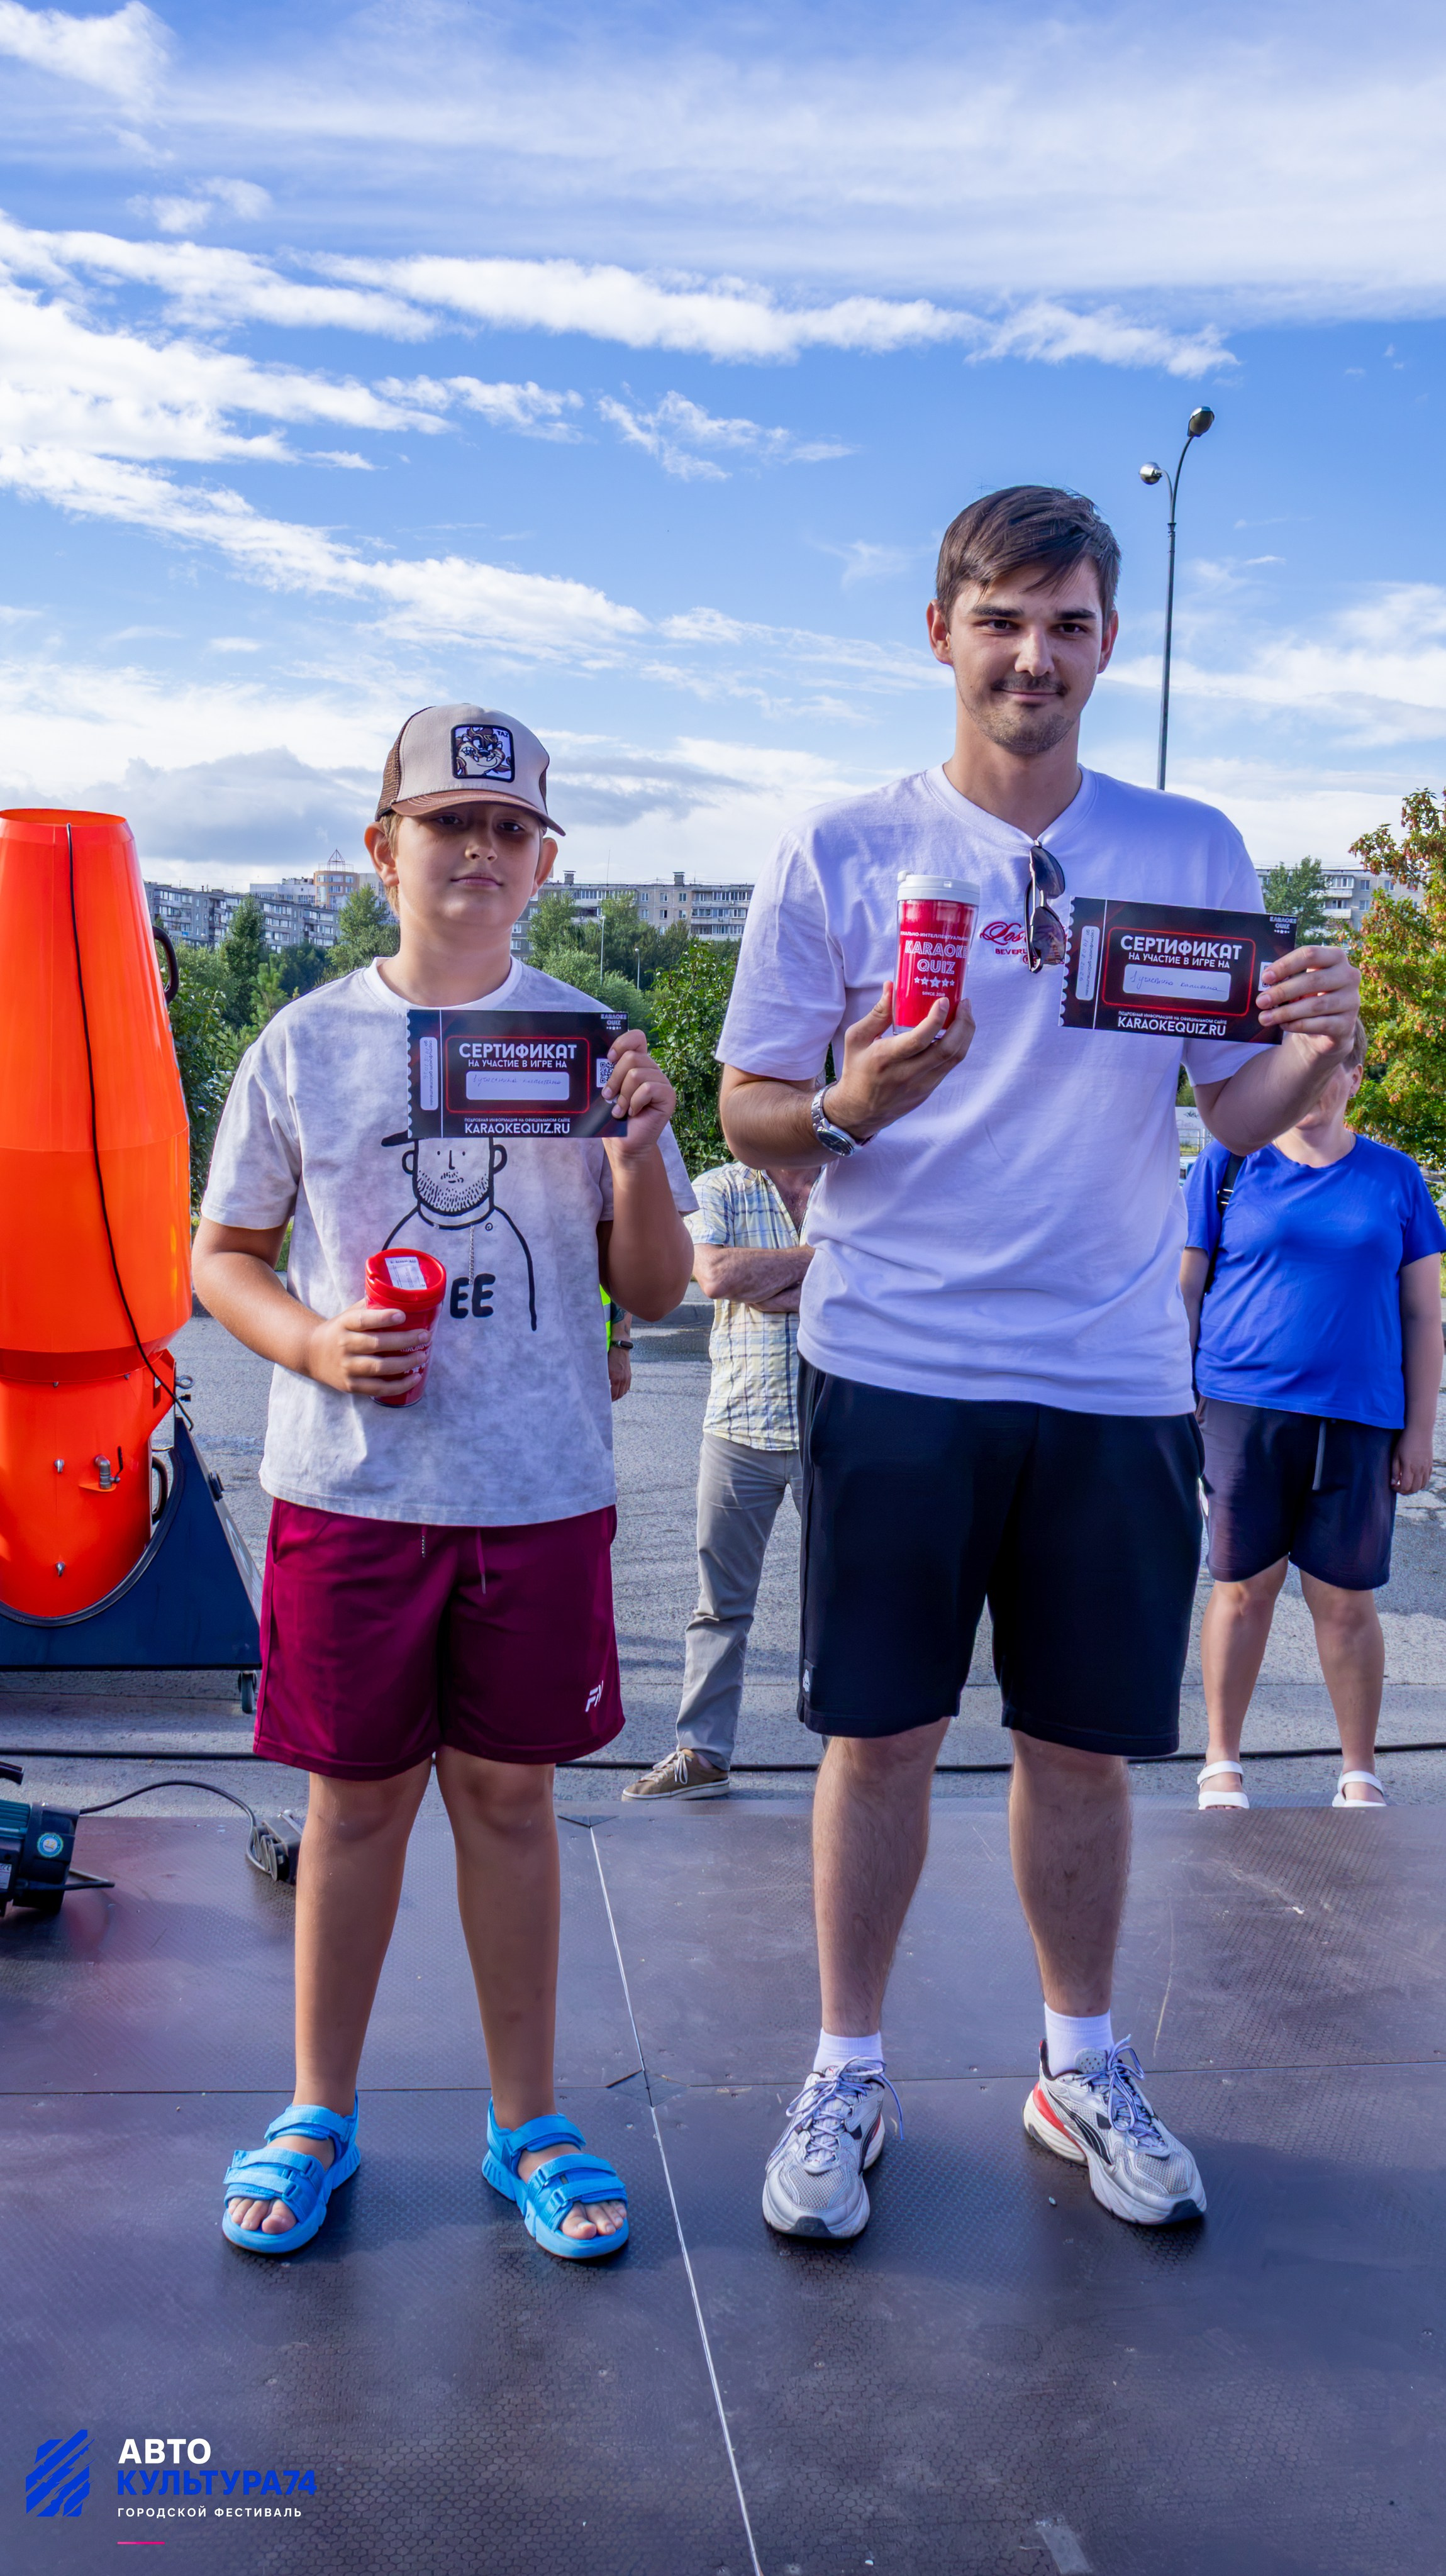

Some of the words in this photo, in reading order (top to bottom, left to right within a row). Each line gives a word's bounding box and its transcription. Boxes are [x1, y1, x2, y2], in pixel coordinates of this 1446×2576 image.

[904, 940, 968, 958] KARAOKE
[1120, 935, 1242, 960] СЕРТИФИКАТ
[916, 958, 955, 974] QUIZ
[1128, 952, 1140, 961] НА
[1143, 953, 1181, 964] УЧАСТИЕ
[1192, 958, 1216, 967] ИГРЕ
[1218, 960, 1230, 969] НА
[1118, 1016, 1226, 1036] KARAOKEQUIZ.RU
[459, 1043, 577, 1059] СЕРТИФИКАТ
[530, 1060, 552, 1068] ИГРЕ
[465, 1123, 570, 1134] KARAOKEQUIZ.RU
